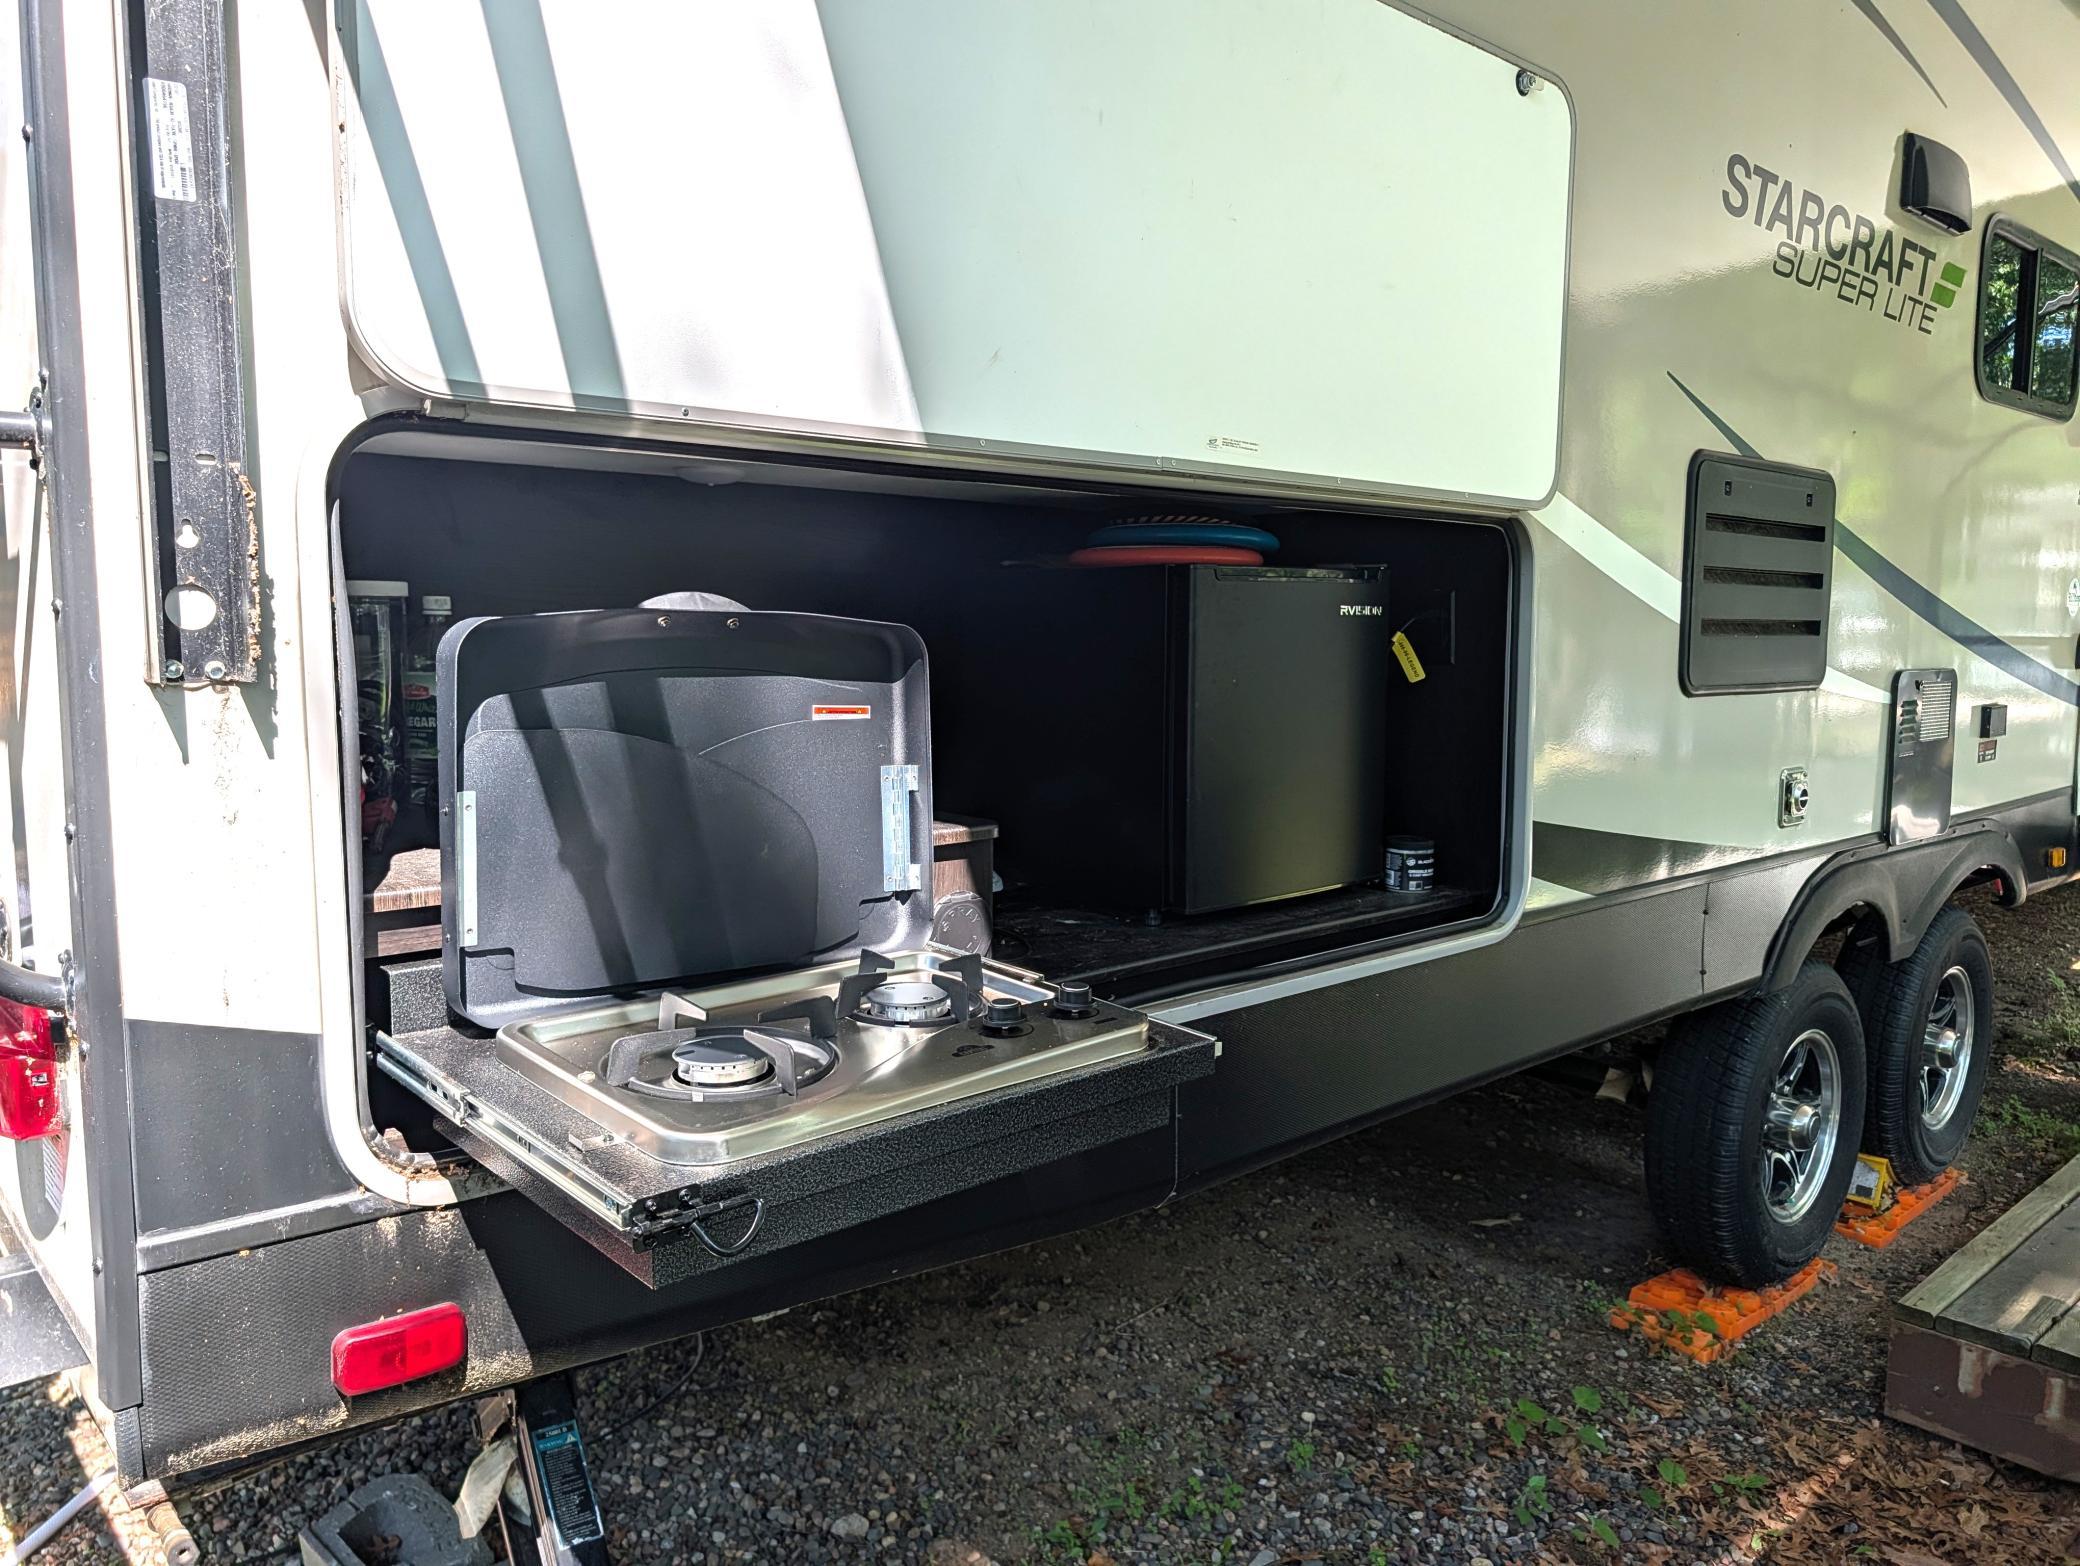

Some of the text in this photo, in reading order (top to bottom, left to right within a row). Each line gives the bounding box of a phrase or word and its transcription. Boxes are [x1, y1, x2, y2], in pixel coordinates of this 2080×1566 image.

[1722, 153, 1937, 297] STARCRAFT
[1772, 241, 1938, 335] SUPER LITE
[1340, 604, 1383, 616] RVISION
